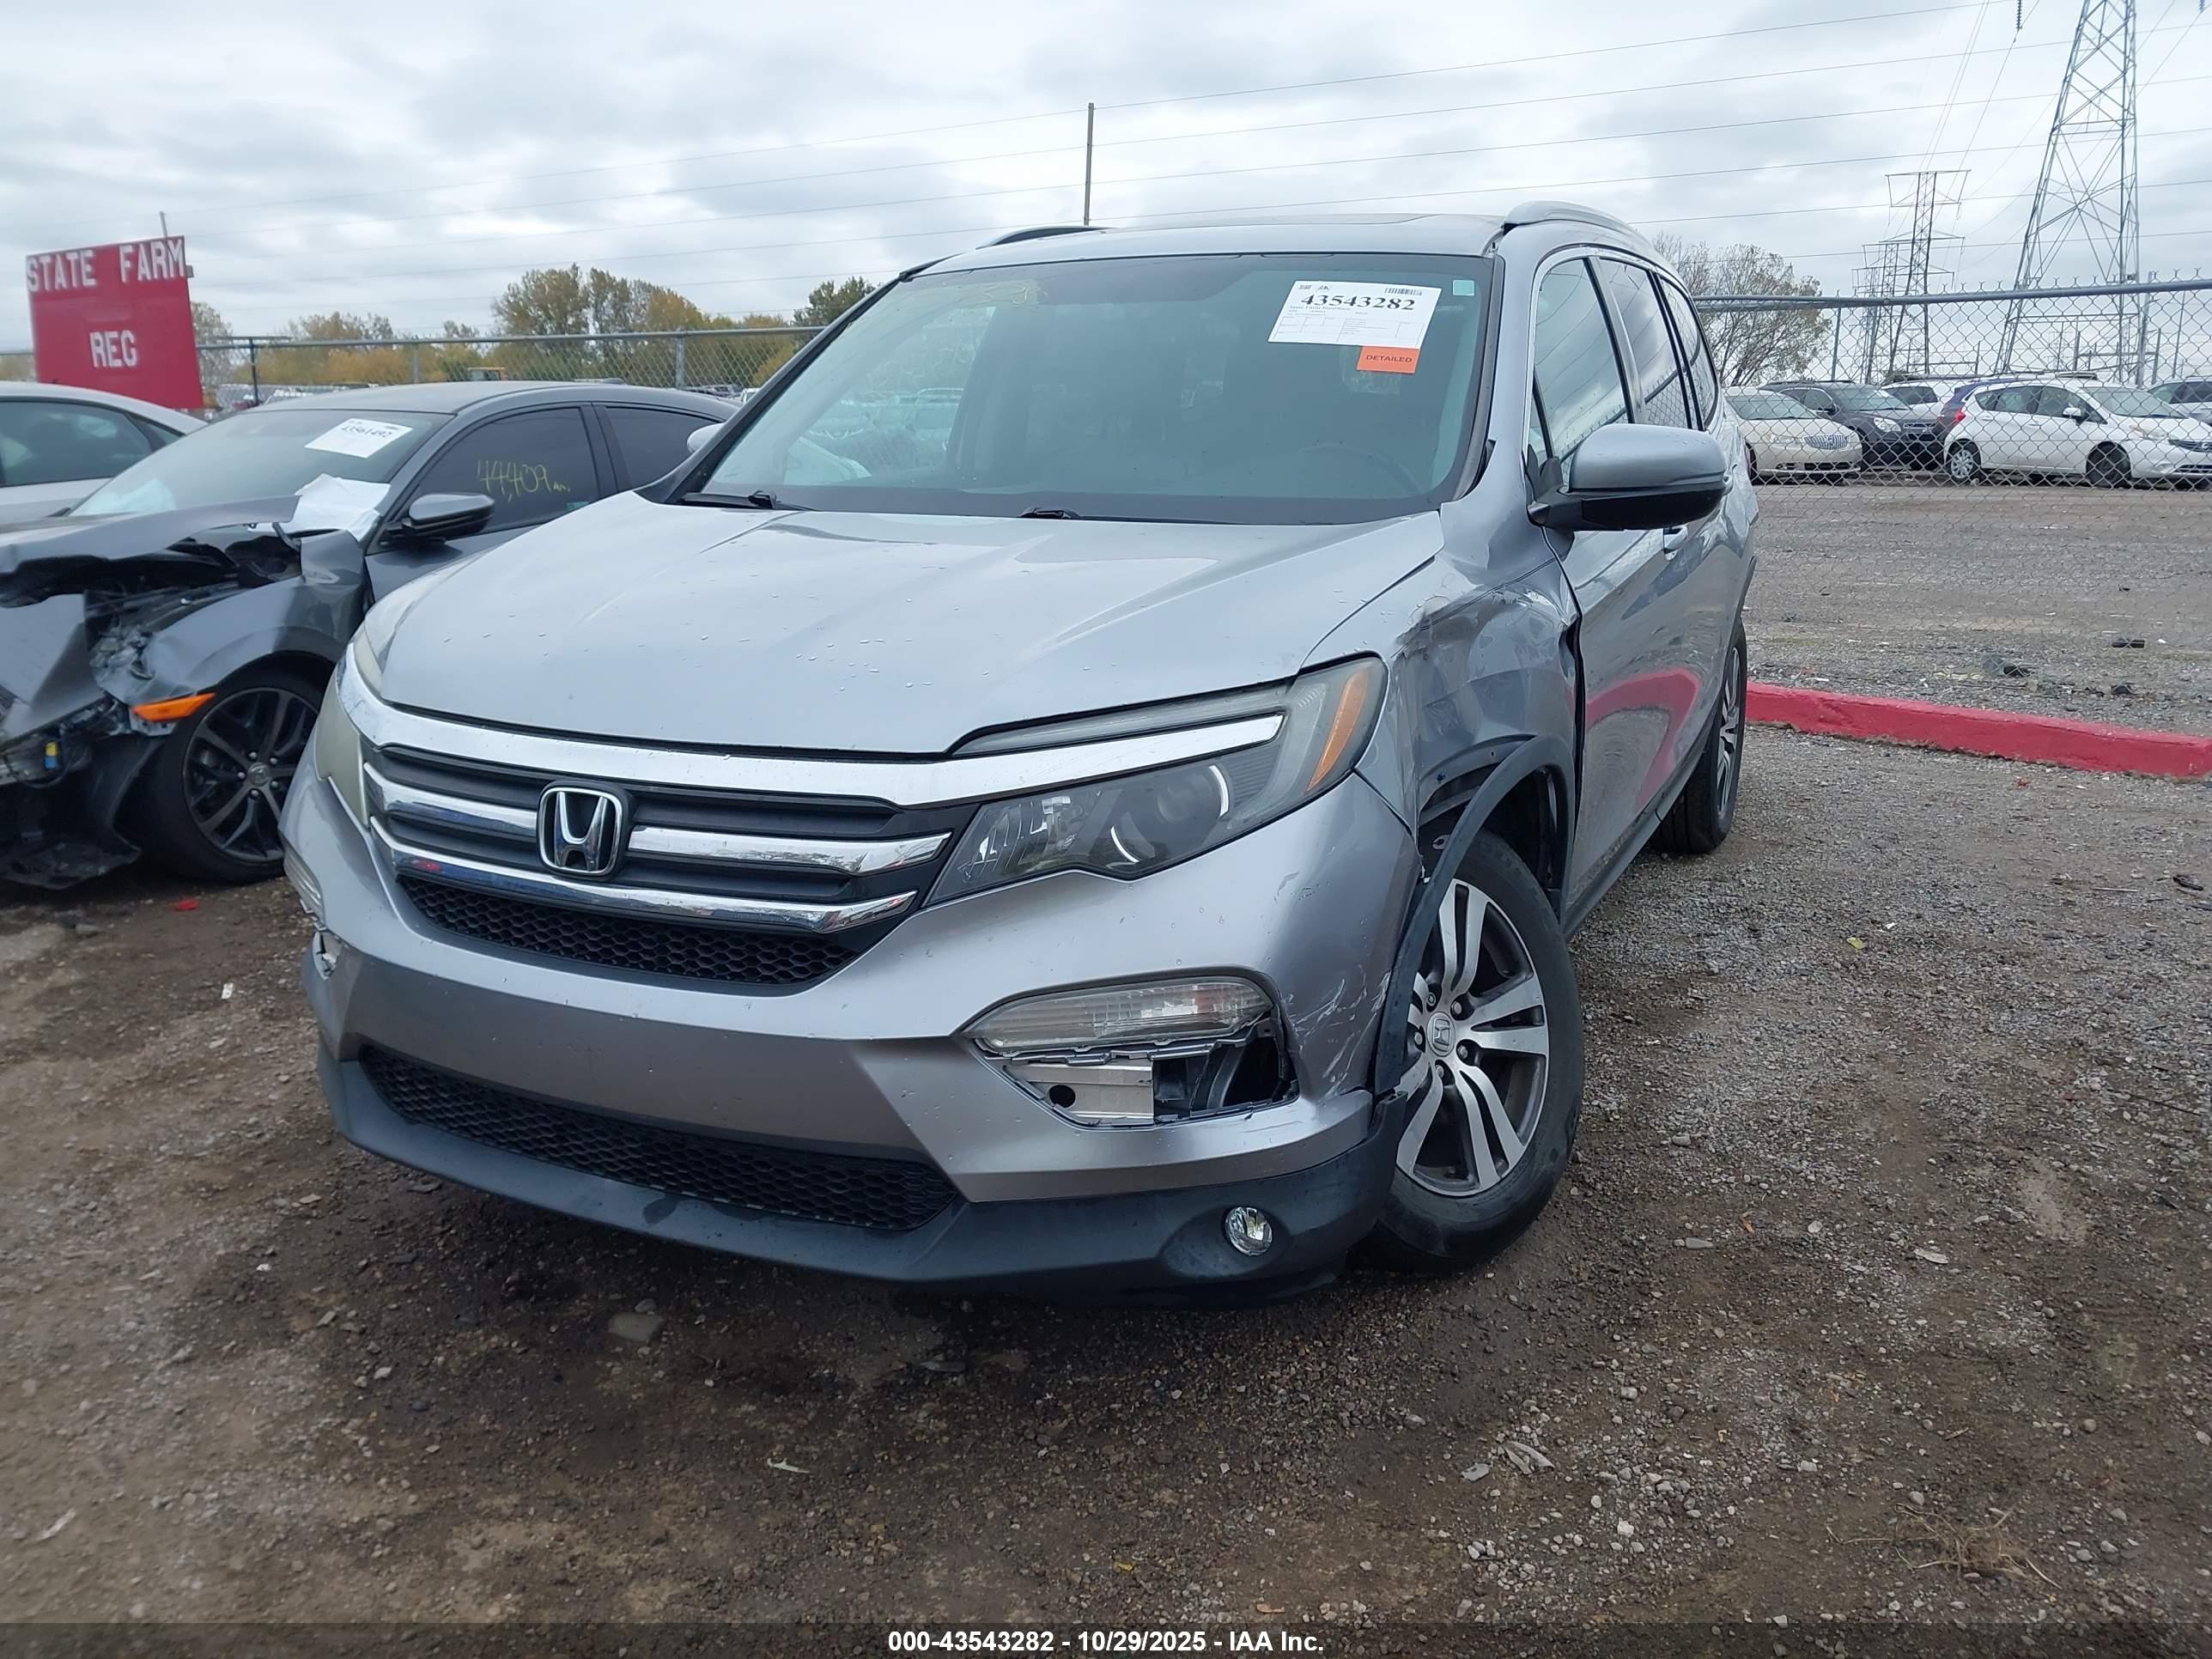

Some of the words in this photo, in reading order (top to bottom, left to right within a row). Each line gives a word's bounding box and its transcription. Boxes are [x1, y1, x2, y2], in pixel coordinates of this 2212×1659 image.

[26, 248, 97, 293] STATE
[118, 239, 185, 283] FARM
[1300, 294, 1416, 311] 43543282
[1365, 354, 1413, 364] DETAILED
